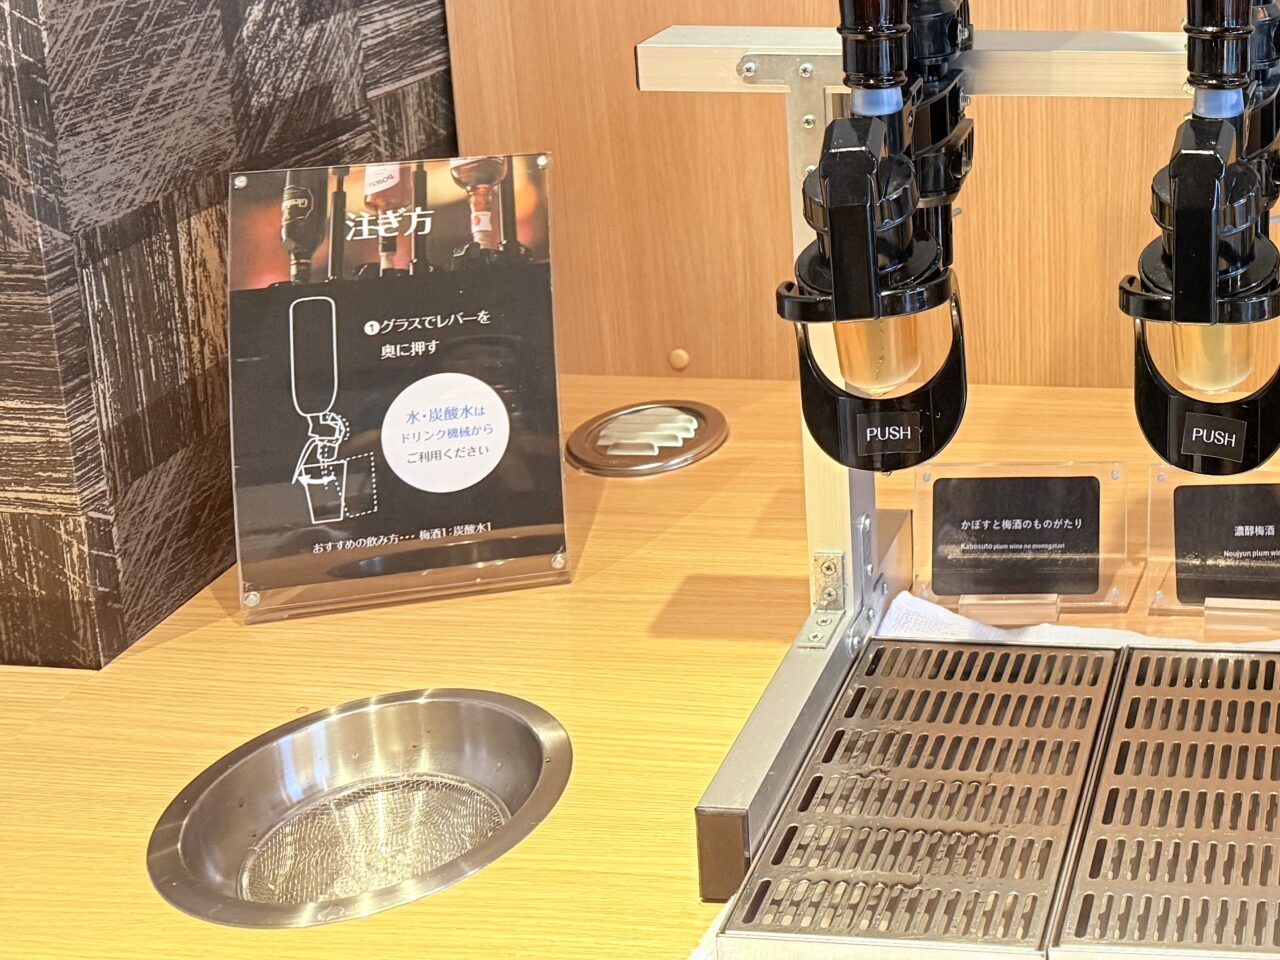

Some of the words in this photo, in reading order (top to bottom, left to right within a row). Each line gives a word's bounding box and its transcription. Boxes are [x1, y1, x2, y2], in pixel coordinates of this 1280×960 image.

[344, 207, 434, 240] 注ぎ方
[380, 339, 440, 359] 奥に押す
[405, 405, 486, 425] 水・炭酸水は
[401, 424, 494, 445] ドリンク機械から
[866, 426, 911, 442] PUSH
[1192, 427, 1236, 448] PUSH
[407, 445, 490, 464] ご利用ください
[960, 518, 1083, 530] かぼすと梅酒のものがたり
[1234, 525, 1275, 536] 濃醇梅酒
[1252, 550, 1270, 558] plum
